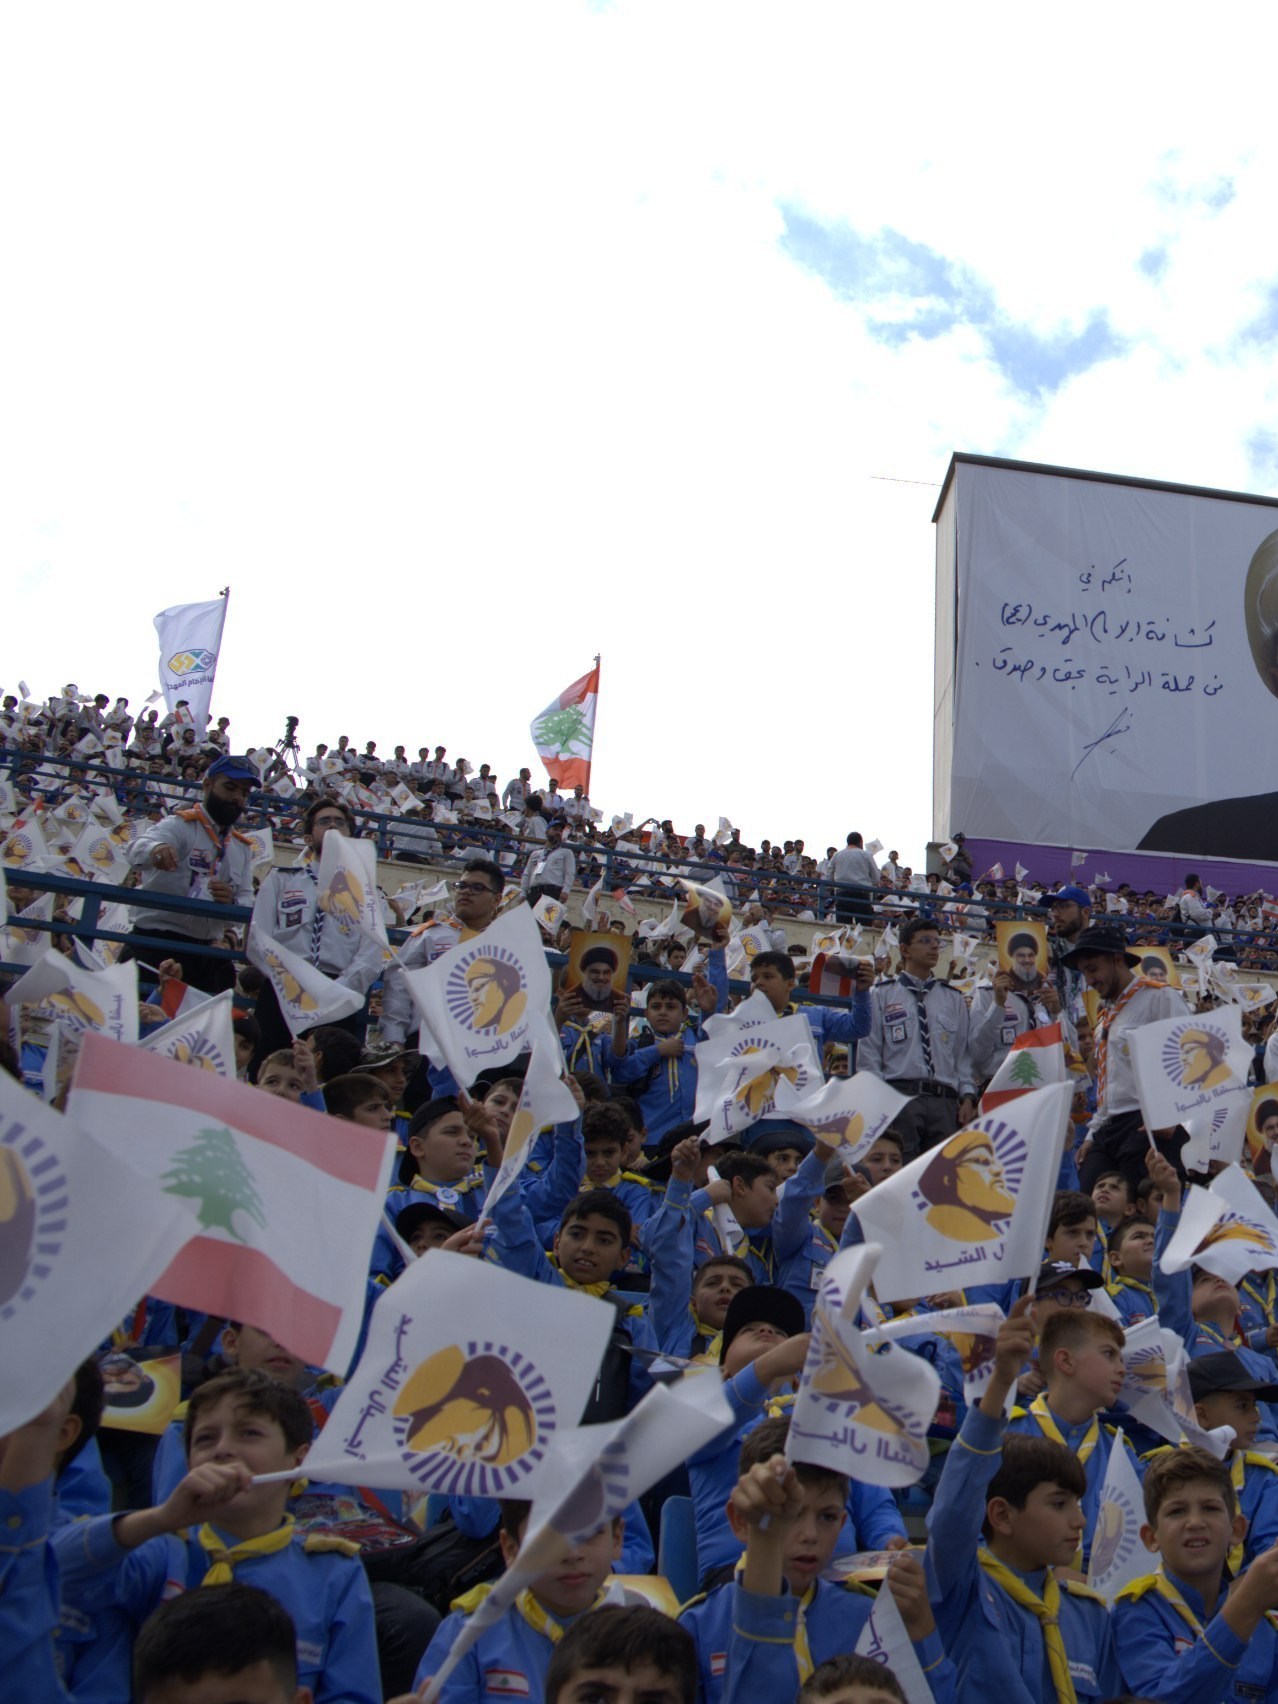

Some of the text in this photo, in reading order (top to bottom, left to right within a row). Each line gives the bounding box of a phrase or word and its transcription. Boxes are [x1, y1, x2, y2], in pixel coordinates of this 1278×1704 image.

[1079, 565, 1095, 592] في
[1033, 612, 1089, 645] المهدي
[1096, 665, 1152, 695] الراية
